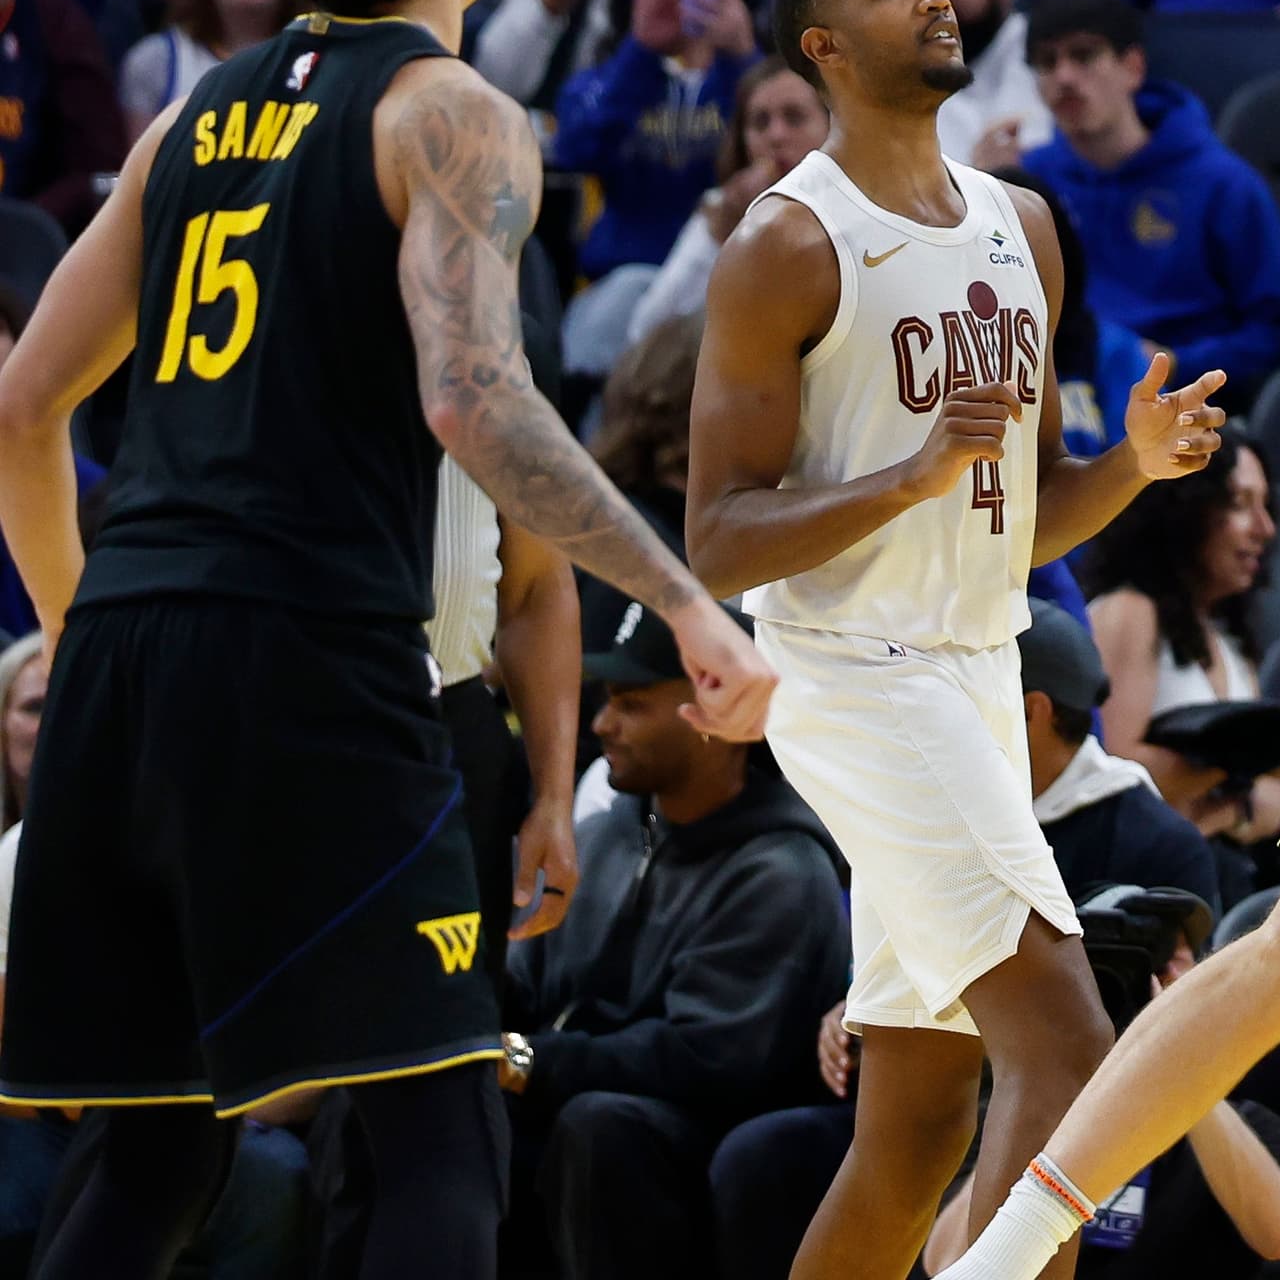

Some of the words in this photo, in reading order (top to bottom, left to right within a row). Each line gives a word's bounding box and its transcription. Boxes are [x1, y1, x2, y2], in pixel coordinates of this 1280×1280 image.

[155, 202, 271, 384] 15
[989, 252, 1025, 269] CLIFFS
[891, 307, 1040, 415] CAVS
[971, 455, 1005, 536] 4
